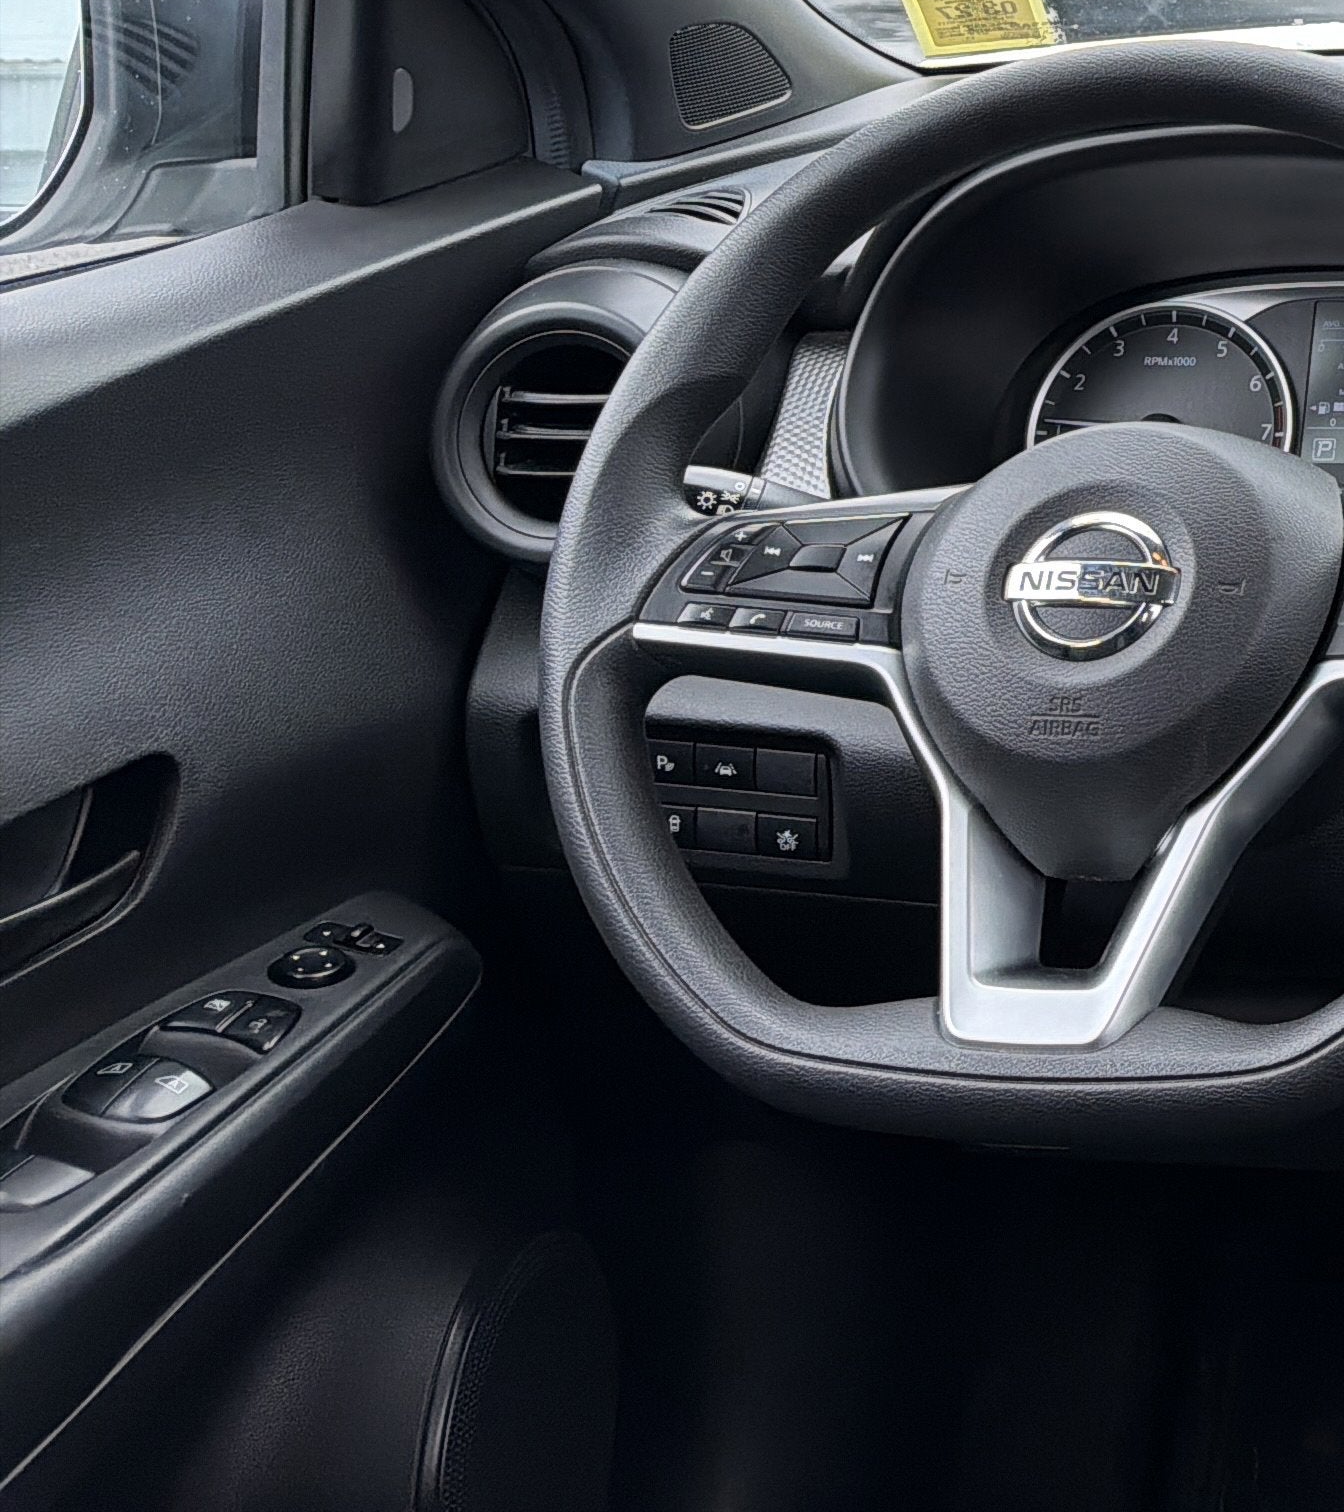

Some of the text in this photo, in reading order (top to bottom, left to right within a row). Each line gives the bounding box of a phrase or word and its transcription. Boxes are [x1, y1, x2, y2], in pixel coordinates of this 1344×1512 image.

[1166, 328, 1178, 344] 4
[1113, 340, 1125, 357] 3
[1216, 341, 1228, 357] 5
[1143, 356, 1197, 366] RPMx1000
[1073, 373, 1085, 390] 2
[1250, 375, 1261, 391] 6
[1330, 418, 1336, 426] 0
[1261, 423, 1272, 441] 7
[1316, 440, 1332, 457] P
[1019, 570, 1160, 596] NISSAN
[803, 618, 844, 630] SOURCE
[1049, 695, 1082, 713] SRS
[1028, 719, 1100, 737] AIRBAG
[780, 843, 797, 851] OFF
